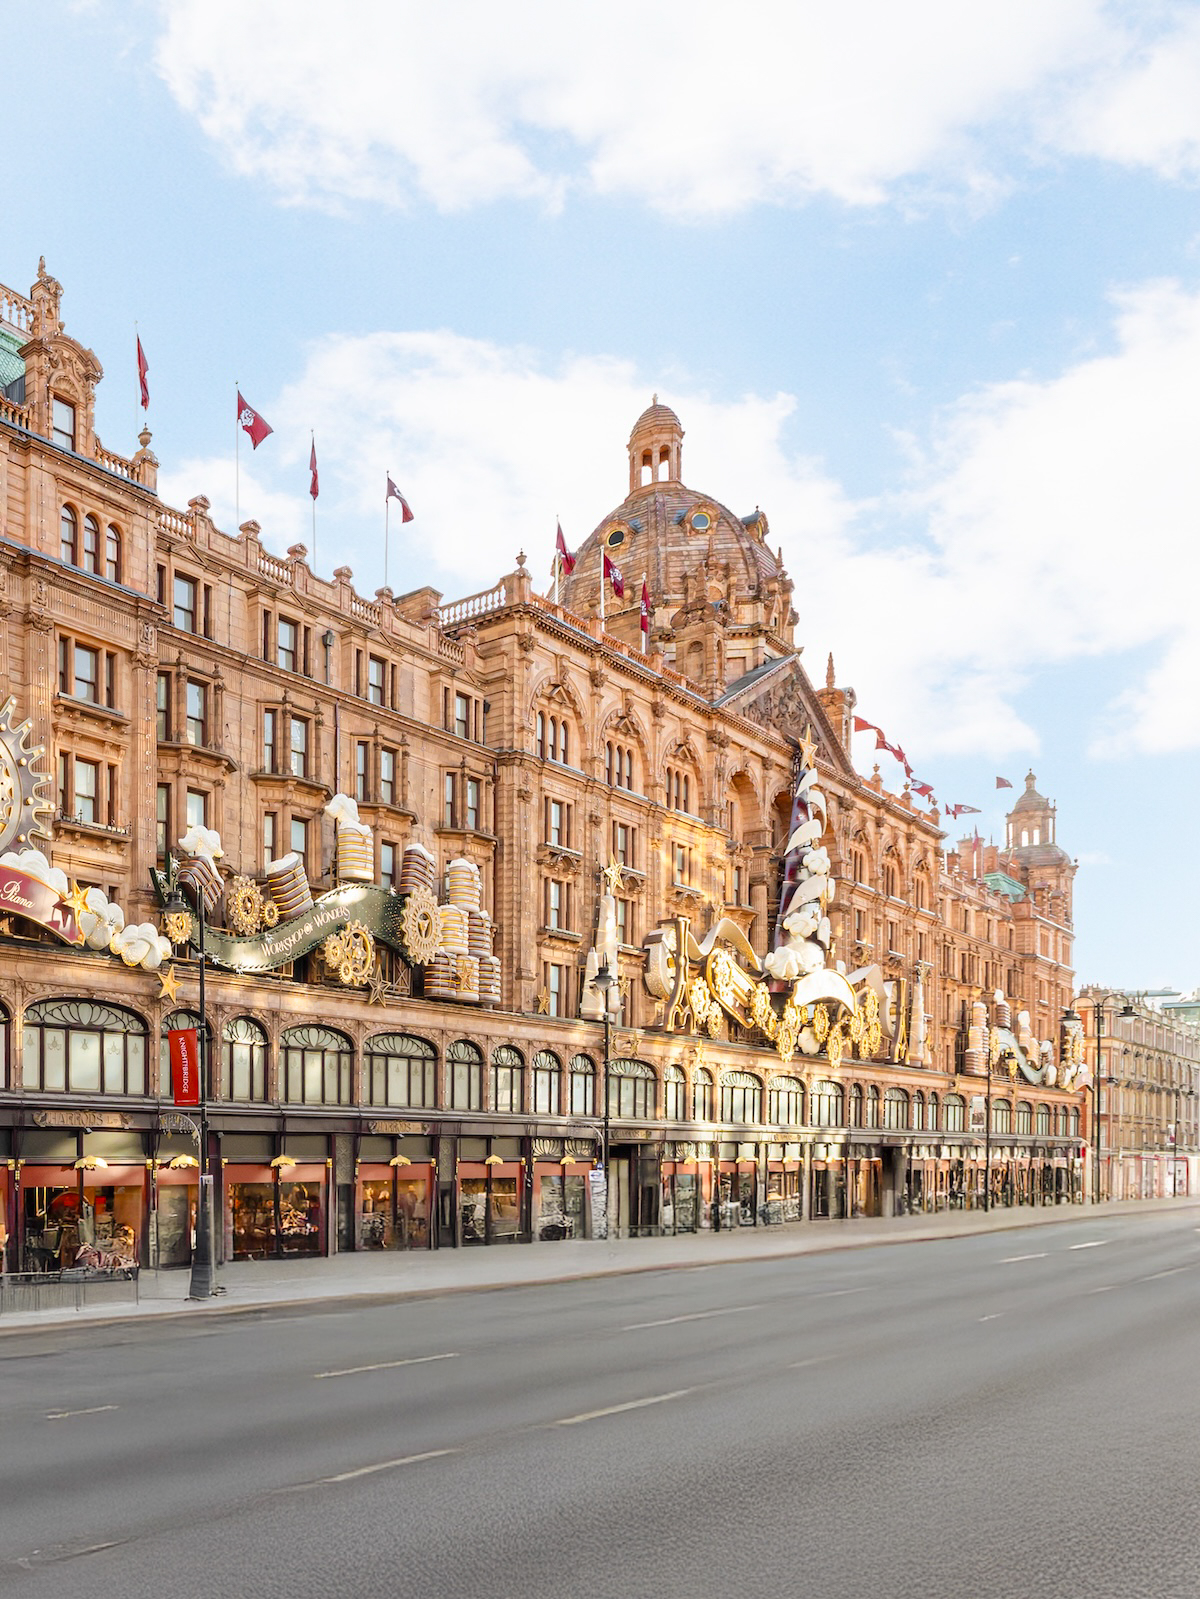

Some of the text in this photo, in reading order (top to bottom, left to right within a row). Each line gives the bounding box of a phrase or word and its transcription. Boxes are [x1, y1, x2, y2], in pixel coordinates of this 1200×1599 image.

[0, 880, 35, 908] Piana
[261, 928, 304, 956] WORKSHOP
[313, 906, 351, 927] WONDERS
